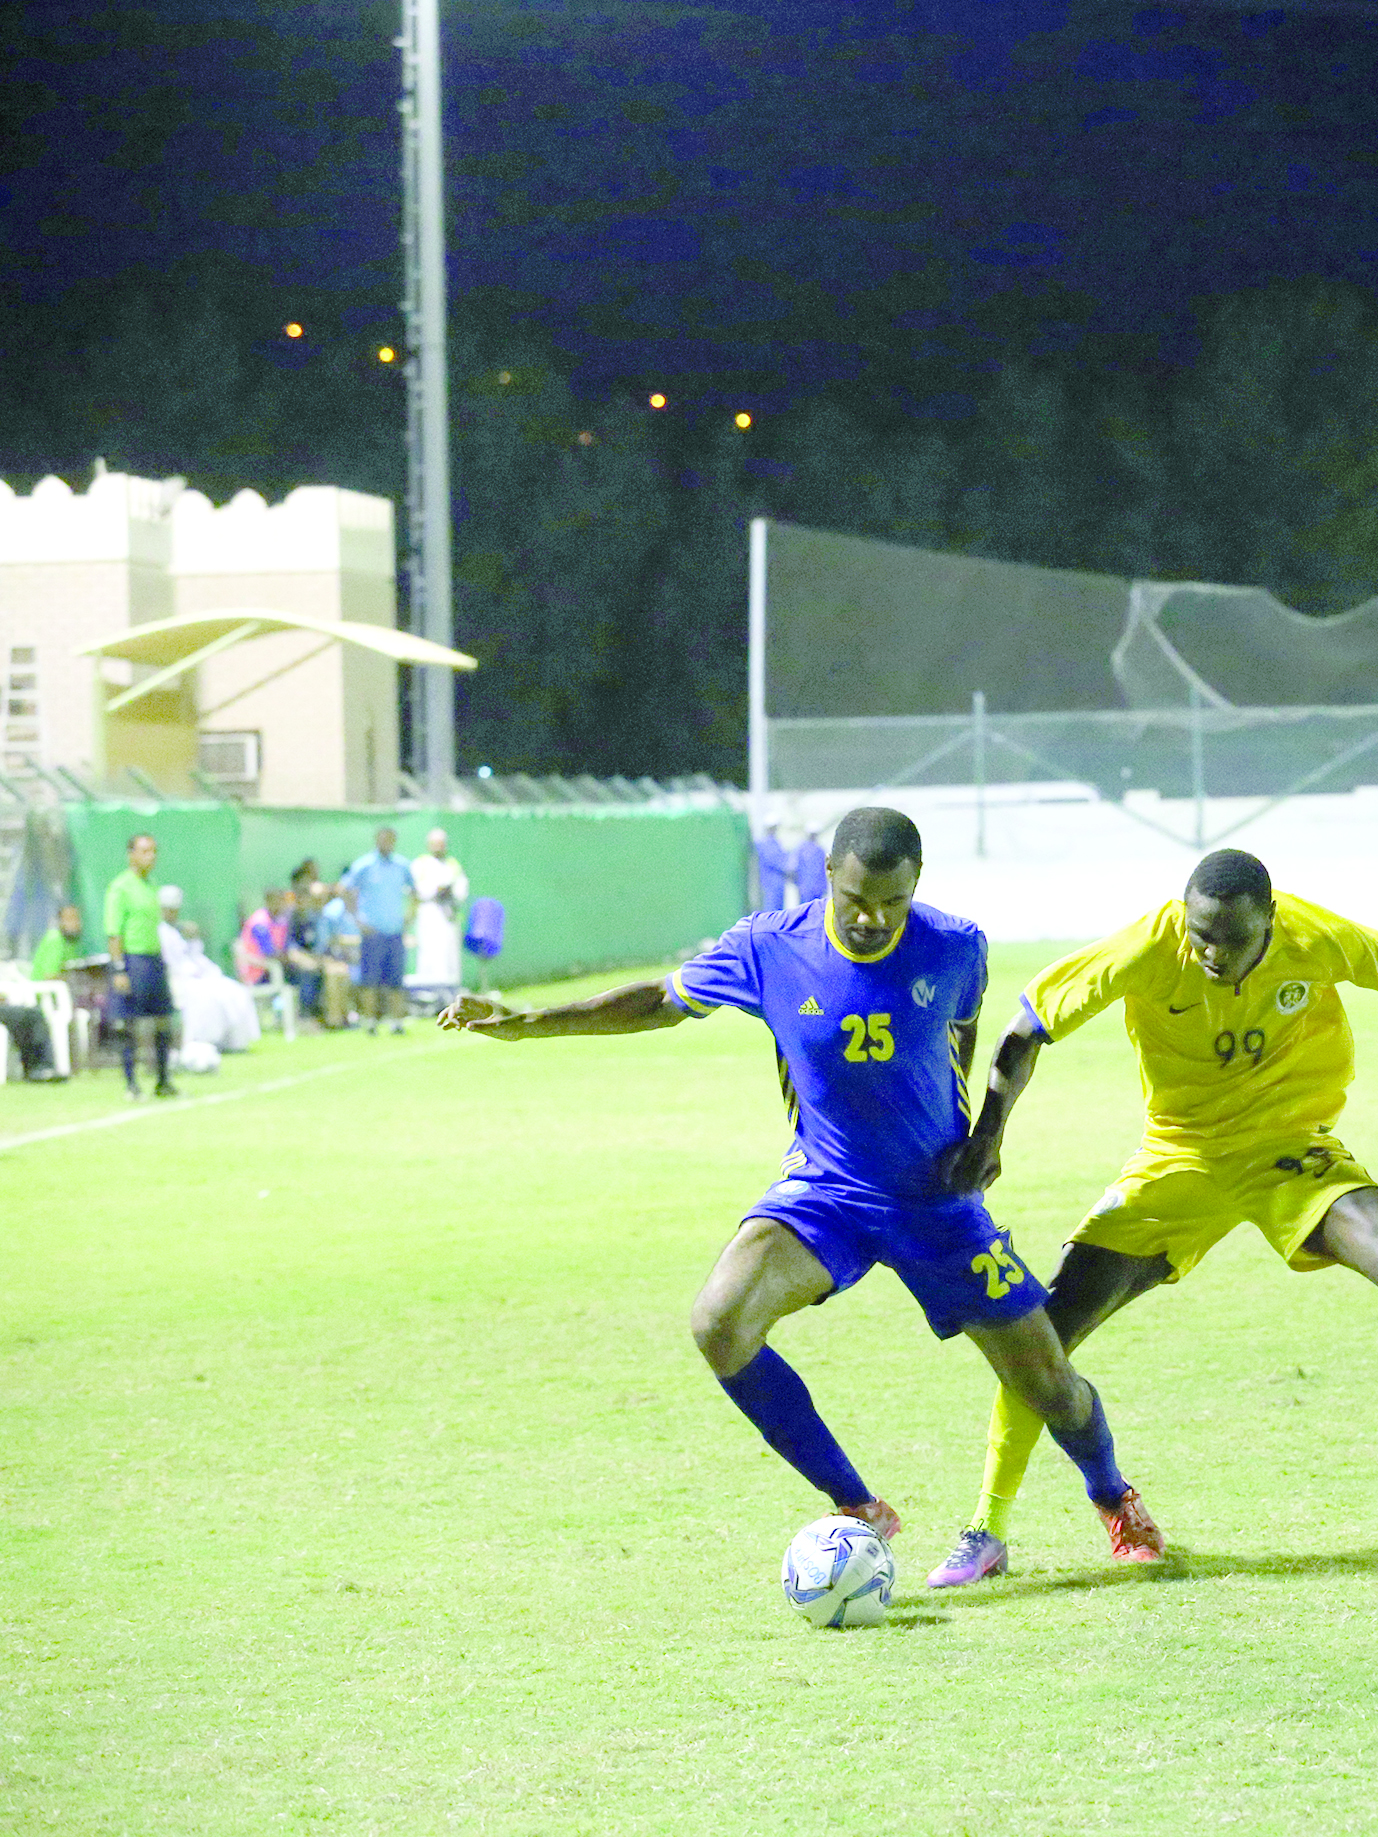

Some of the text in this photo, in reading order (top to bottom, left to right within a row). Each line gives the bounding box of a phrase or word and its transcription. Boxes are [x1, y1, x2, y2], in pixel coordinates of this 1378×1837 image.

[841, 1013, 895, 1062] 25
[1214, 1029, 1266, 1068] 99
[971, 1239, 1025, 1299] 25
